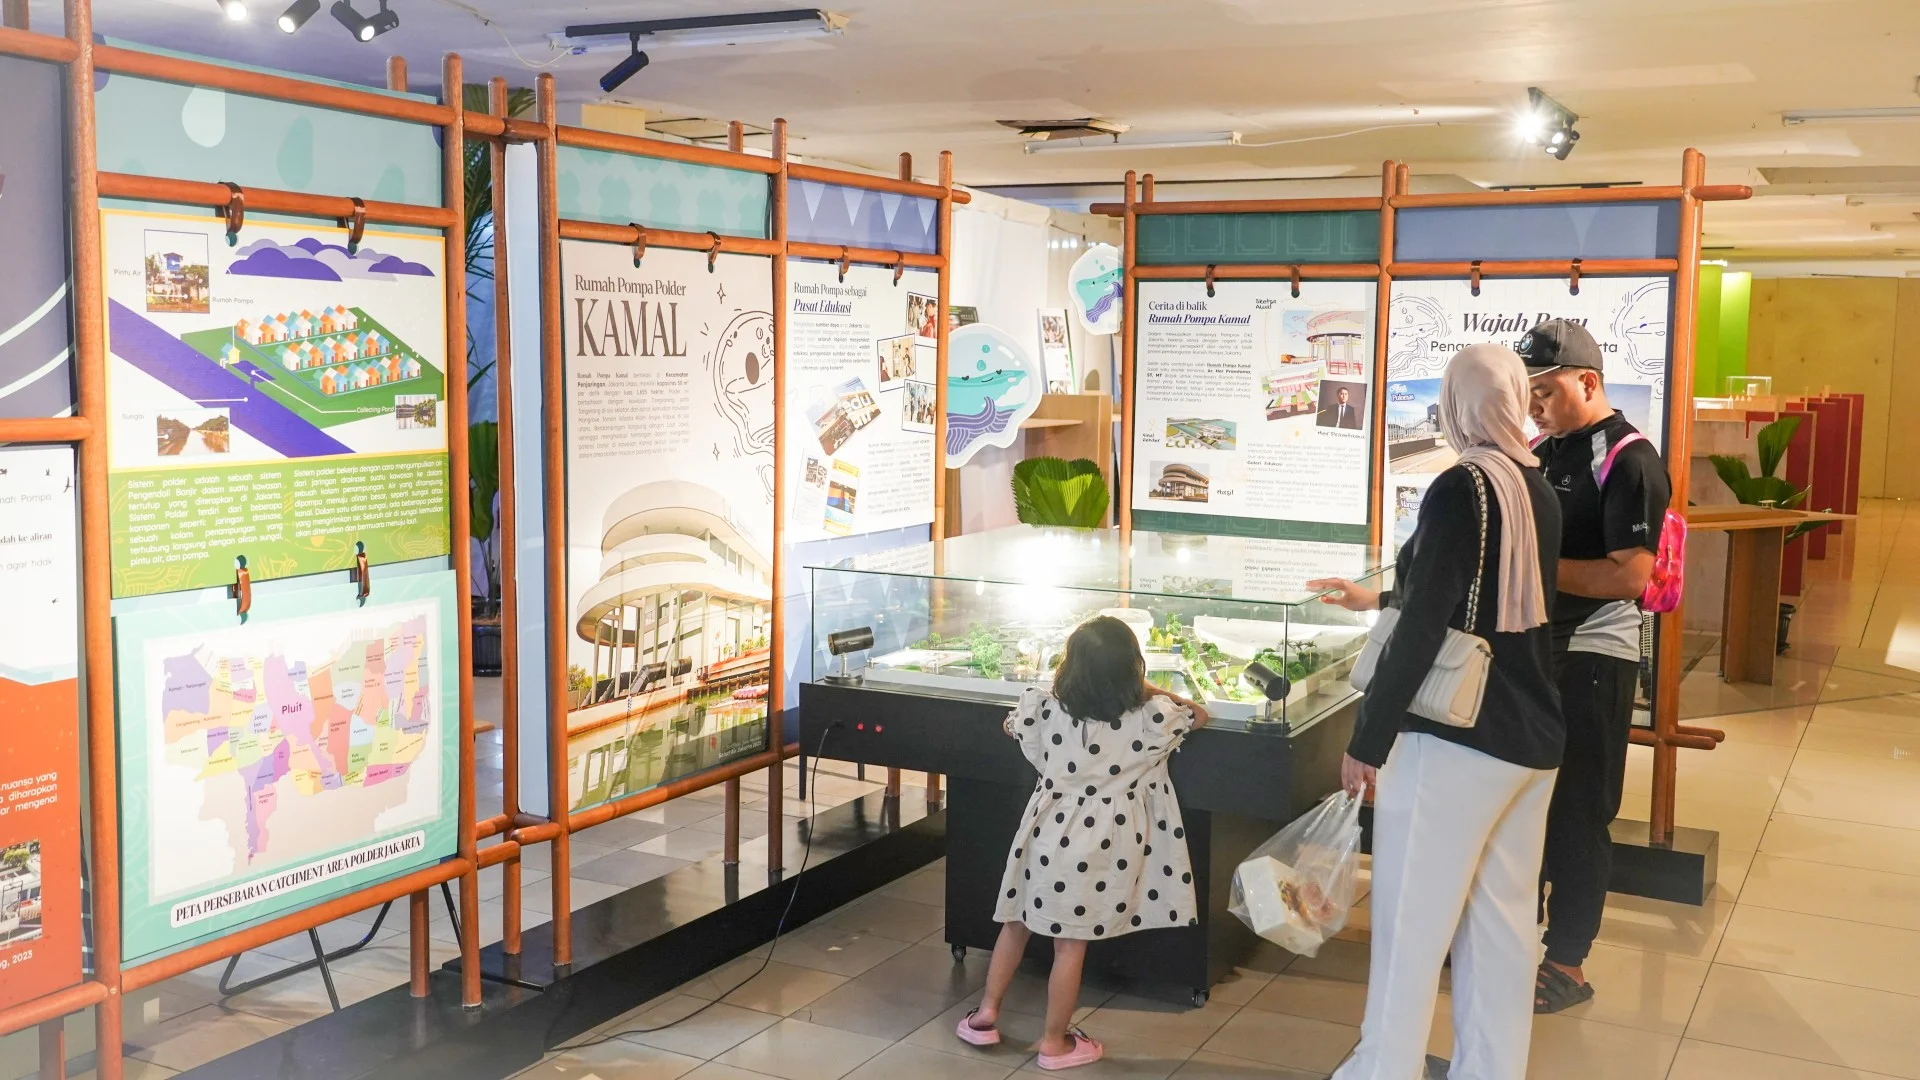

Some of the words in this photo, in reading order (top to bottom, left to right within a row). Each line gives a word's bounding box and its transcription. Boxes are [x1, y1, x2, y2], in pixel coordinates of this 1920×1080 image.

[114, 268, 130, 277] Pintu
[575, 274, 615, 292] Rumah
[618, 277, 653, 297] Pompa
[655, 280, 686, 296] Polder
[795, 282, 819, 294] Rumah
[821, 284, 843, 298] Pompa
[845, 286, 867, 299] sebagai
[235, 297, 254, 305] Pompa
[793, 299, 818, 312] Pusat
[819, 300, 851, 313] Edukasi
[1149, 301, 1174, 311] Cerita
[1176, 302, 1184, 310] di
[1187, 302, 1207, 311] balik
[575, 298, 686, 356] KAMAL
[1149, 314, 1182, 323] Rumah
[1184, 314, 1216, 325] Pompa
[1218, 315, 1251, 324] Kamal
[1463, 312, 1528, 336] Wajah
[122, 413, 145, 422] Sungai
[356, 406, 380, 415] Collecting
[294, 469, 315, 477] Sistem
[316, 467, 335, 476] polder
[337, 466, 358, 475] bekerja
[360, 464, 380, 473] dengan
[395, 461, 435, 470] mengumpulkan
[128, 480, 153, 489] Sistem
[162, 478, 186, 488] polder
[194, 476, 220, 485] adalah
[227, 474, 253, 482] sebuah
[294, 479, 307, 488] dari
[312, 478, 336, 487] jaringan
[341, 476, 366, 484] drainase
[389, 472, 413, 480] kawasan
[295, 489, 317, 498] sebuah
[321, 487, 339, 495] kolam
[343, 484, 385, 494] penampungan.
[399, 481, 412, 489] yang
[416, 479, 443, 487] ditampung
[21, 493, 52, 502] Pompa
[128, 490, 170, 501] Pengendali
[176, 488, 197, 497] Banjir
[202, 486, 224, 494] dalam
[253, 482, 282, 490] kawasan
[295, 499, 322, 508] dipompa
[326, 497, 348, 505] menuju
[352, 494, 368, 502] aliran
[391, 491, 408, 499] seperti
[412, 489, 428, 497] sungai
[128, 501, 160, 511] tertutup
[169, 501, 187, 509] yang
[195, 496, 233, 507] diterapkan
[255, 492, 282, 501] Jakarta.
[295, 509, 313, 517] kanal.
[315, 507, 335, 516] Dalam
[351, 504, 367, 512] aliran
[368, 503, 388, 511] sungai,
[402, 499, 427, 507] beberapa
[428, 497, 443, 505] polder
[129, 513, 155, 522] Sistem
[165, 510, 188, 519] Polder
[198, 508, 219, 516] terdiri
[228, 505, 242, 513] dari
[251, 503, 282, 512] beberapa
[295, 519, 311, 528] yang
[313, 516, 351, 526] mengirimkan
[363, 512, 384, 520] Seluruh
[401, 509, 417, 517] sungai
[419, 506, 443, 514] kemudian
[129, 523, 170, 534] komponen
[180, 519, 206, 529] seperti:
[215, 516, 244, 526] jaringan
[252, 513, 283, 522] drainase,
[312, 526, 344, 535] diteruskan
[358, 522, 385, 530] bermuara
[386, 520, 405, 528] menuju
[18, 534, 28, 542] ke
[30, 533, 53, 541] aliran
[130, 535, 158, 544] sebuah
[171, 531, 193, 540] kolam
[205, 527, 255, 538] penampungan
[266, 523, 283, 532] yang
[130, 544, 169, 555] terhubung
[173, 541, 206, 551] langsung
[209, 538, 235, 547] dengan
[238, 535, 257, 544] aliran
[260, 533, 283, 543] sungai,
[7, 561, 27, 572] agar
[31, 558, 52, 567] tidak
[130, 558, 150, 568] pintu
[153, 556, 165, 564] air,
[166, 554, 181, 562] dan
[182, 551, 209, 562] pompa.
[281, 702, 303, 715] Pluit
[2, 777, 34, 791] nuansa
[36, 772, 58, 784] yang
[8, 784, 58, 801] diharapkan
[176, 901, 202, 922] PETA
[203, 882, 268, 913] PERSEBARAN
[268, 865, 325, 893] CATCHMENT
[325, 857, 349, 875] AREA
[350, 846, 384, 868] POLDER
[384, 836, 421, 858] JAKARTA
[12, 950, 32, 964] 2023
